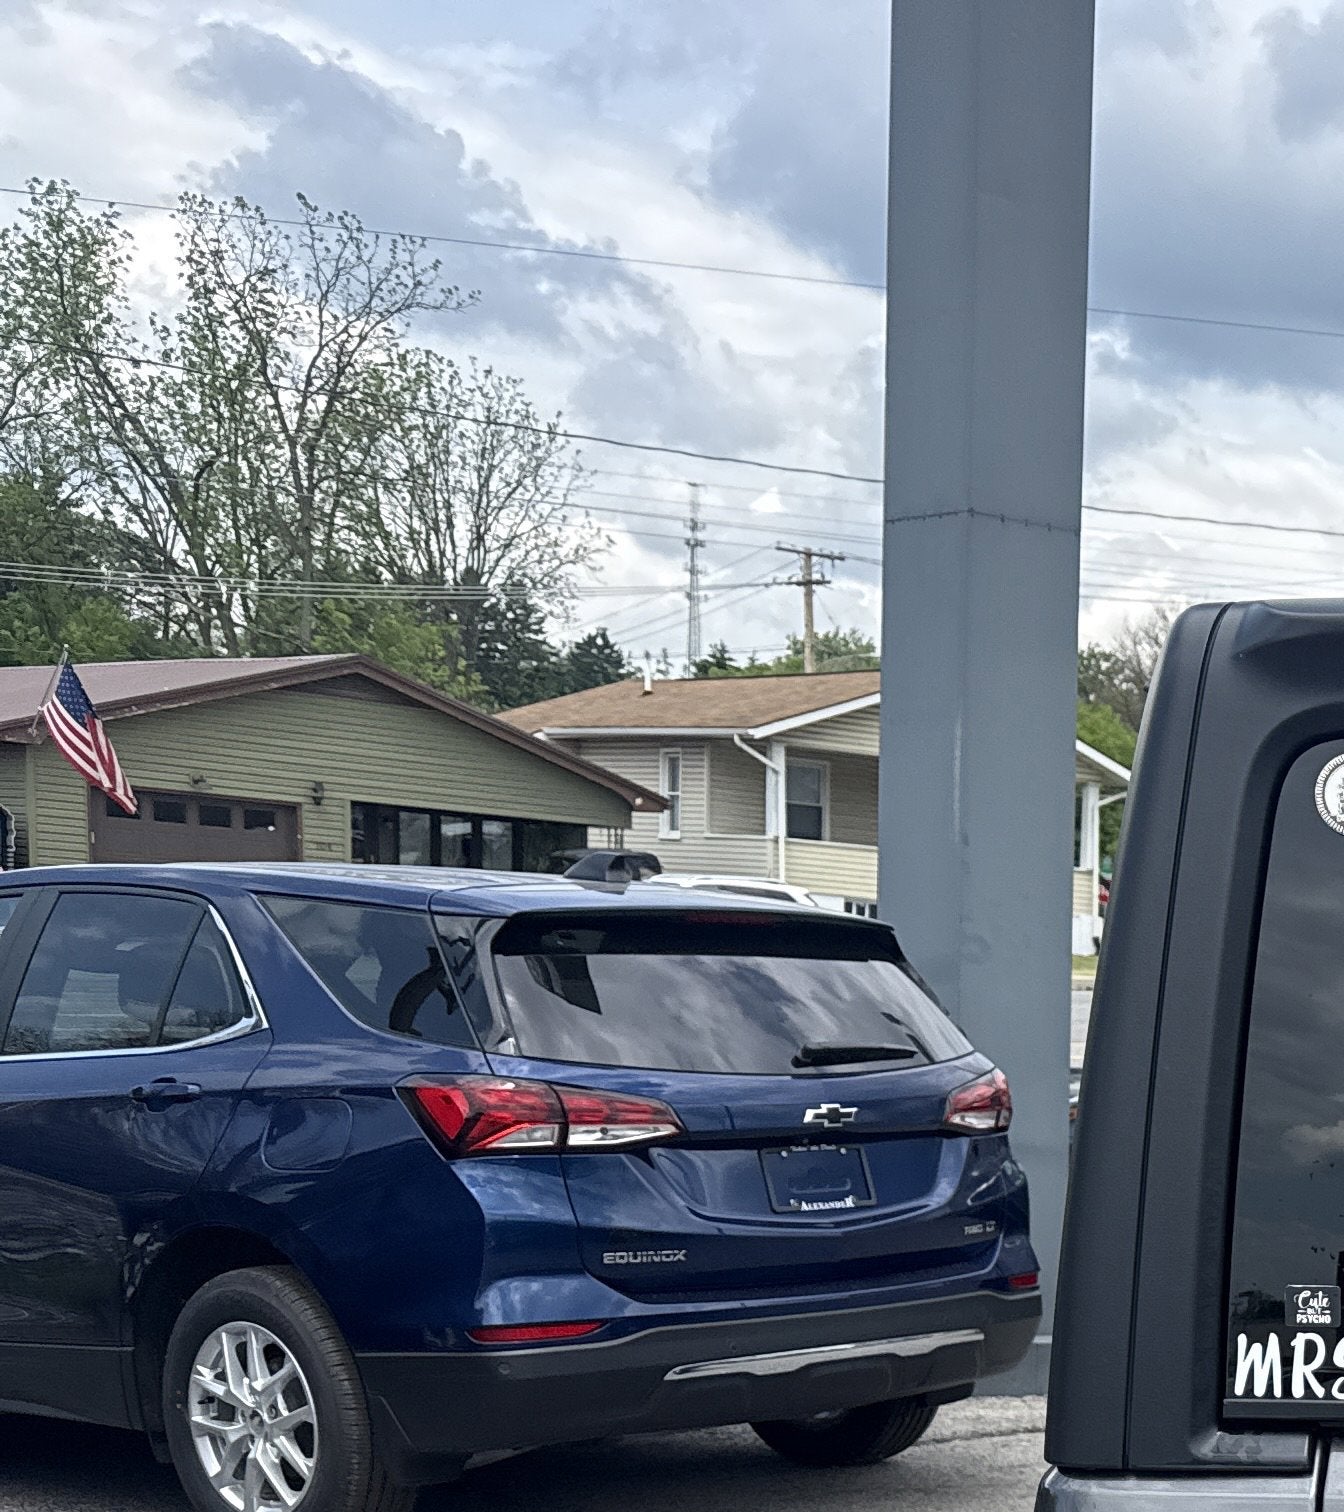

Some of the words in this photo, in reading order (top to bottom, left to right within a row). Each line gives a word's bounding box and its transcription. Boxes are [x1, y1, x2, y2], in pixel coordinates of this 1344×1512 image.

[603, 1250, 687, 1264] EQUINOX
[1293, 1290, 1331, 1309] Cute
[1296, 1314, 1331, 1324] PSYCHO
